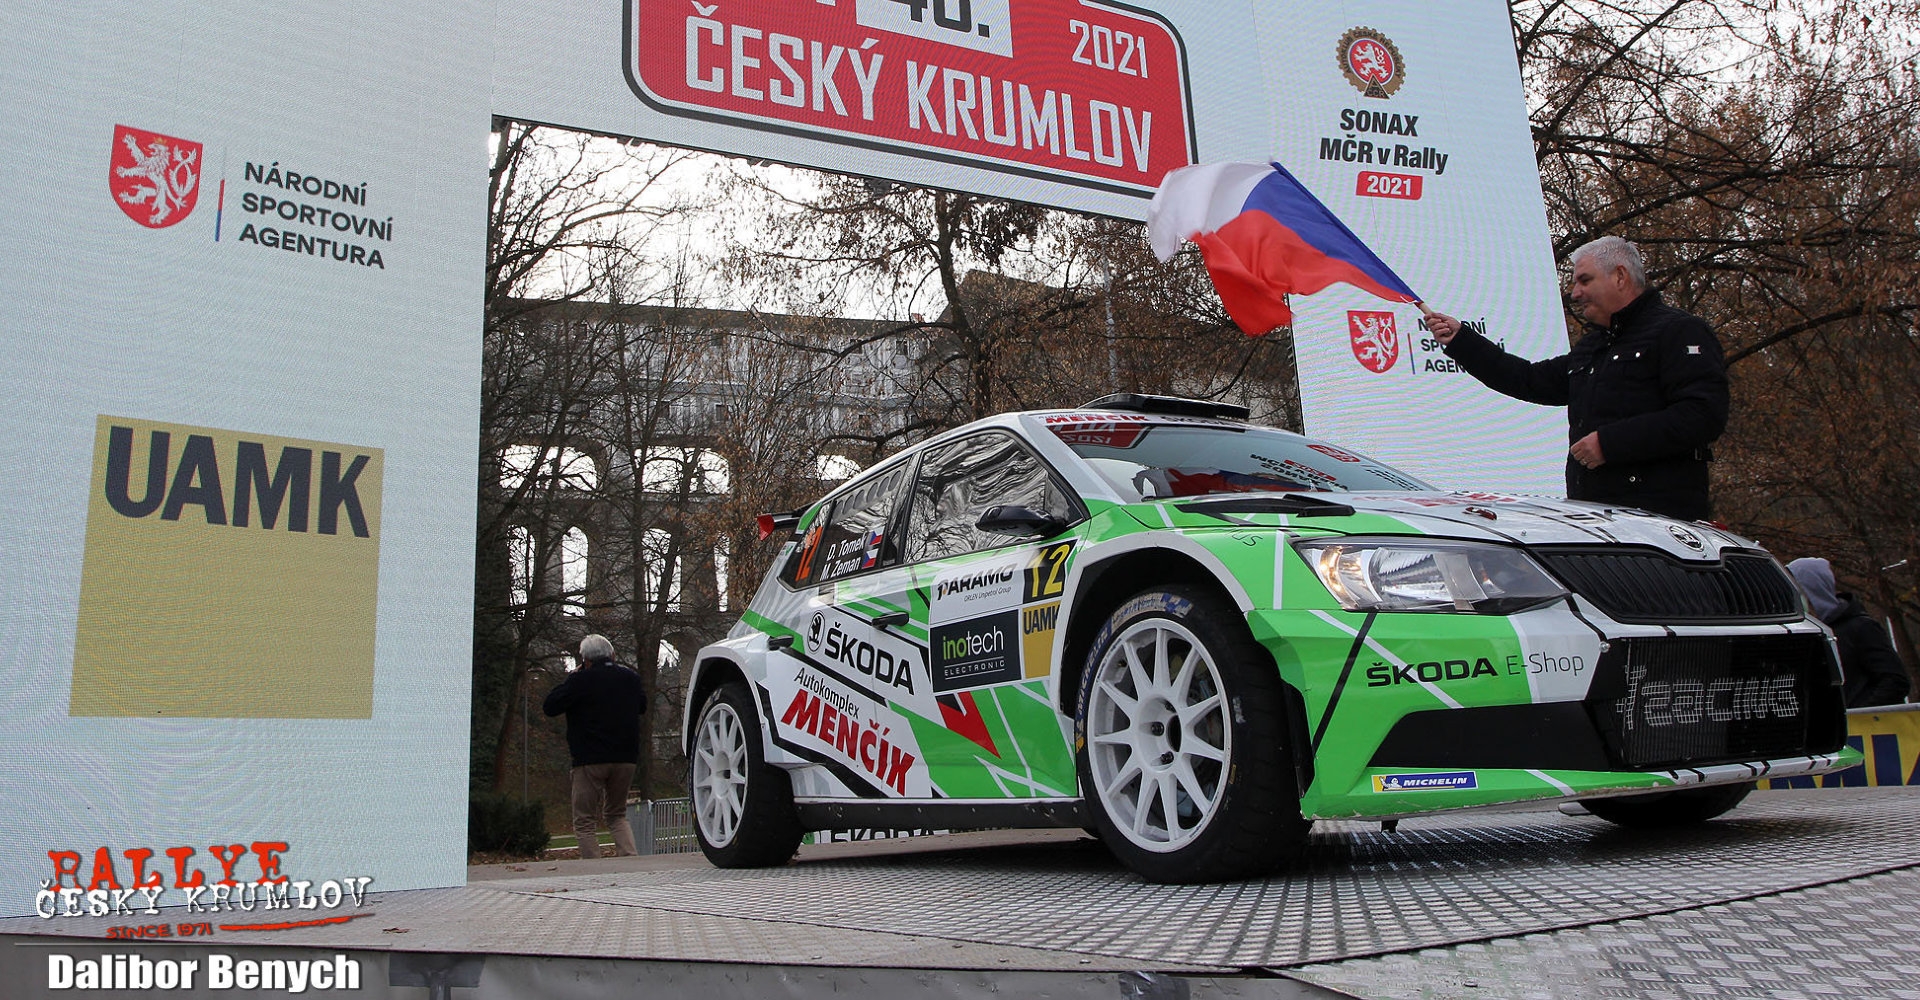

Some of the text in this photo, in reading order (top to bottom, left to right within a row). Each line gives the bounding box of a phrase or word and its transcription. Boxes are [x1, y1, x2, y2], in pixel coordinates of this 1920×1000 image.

[1070, 19, 1148, 79] 2021
[686, 1, 1152, 173] ČESKÝ KRUMLOV
[1340, 108, 1419, 137] SONAX
[1320, 134, 1448, 175] MČR v Rally
[244, 162, 367, 206] NÁRODNÍ
[1366, 175, 1412, 196] 2021
[241, 192, 393, 241] SPORTOVNÍ
[238, 223, 385, 269] AGENTURA
[104, 425, 372, 539] UAMK
[827, 532, 867, 562] D. Tomek
[820, 557, 861, 581] M. Zeman
[937, 563, 1018, 601] PARAMO
[1026, 544, 1070, 598] 12
[964, 594, 978, 602] ORLEN
[998, 586, 1012, 597] Group
[824, 622, 914, 696] ŠKODA
[943, 626, 1004, 660] inotech
[944, 660, 1005, 676] ELECTRONIC
[1366, 652, 1584, 687] ŠKODA E-Shop
[793, 666, 860, 719] Autokomplex
[781, 688, 915, 797] MENČÍK
[1403, 777, 1467, 787] MICHELIN
